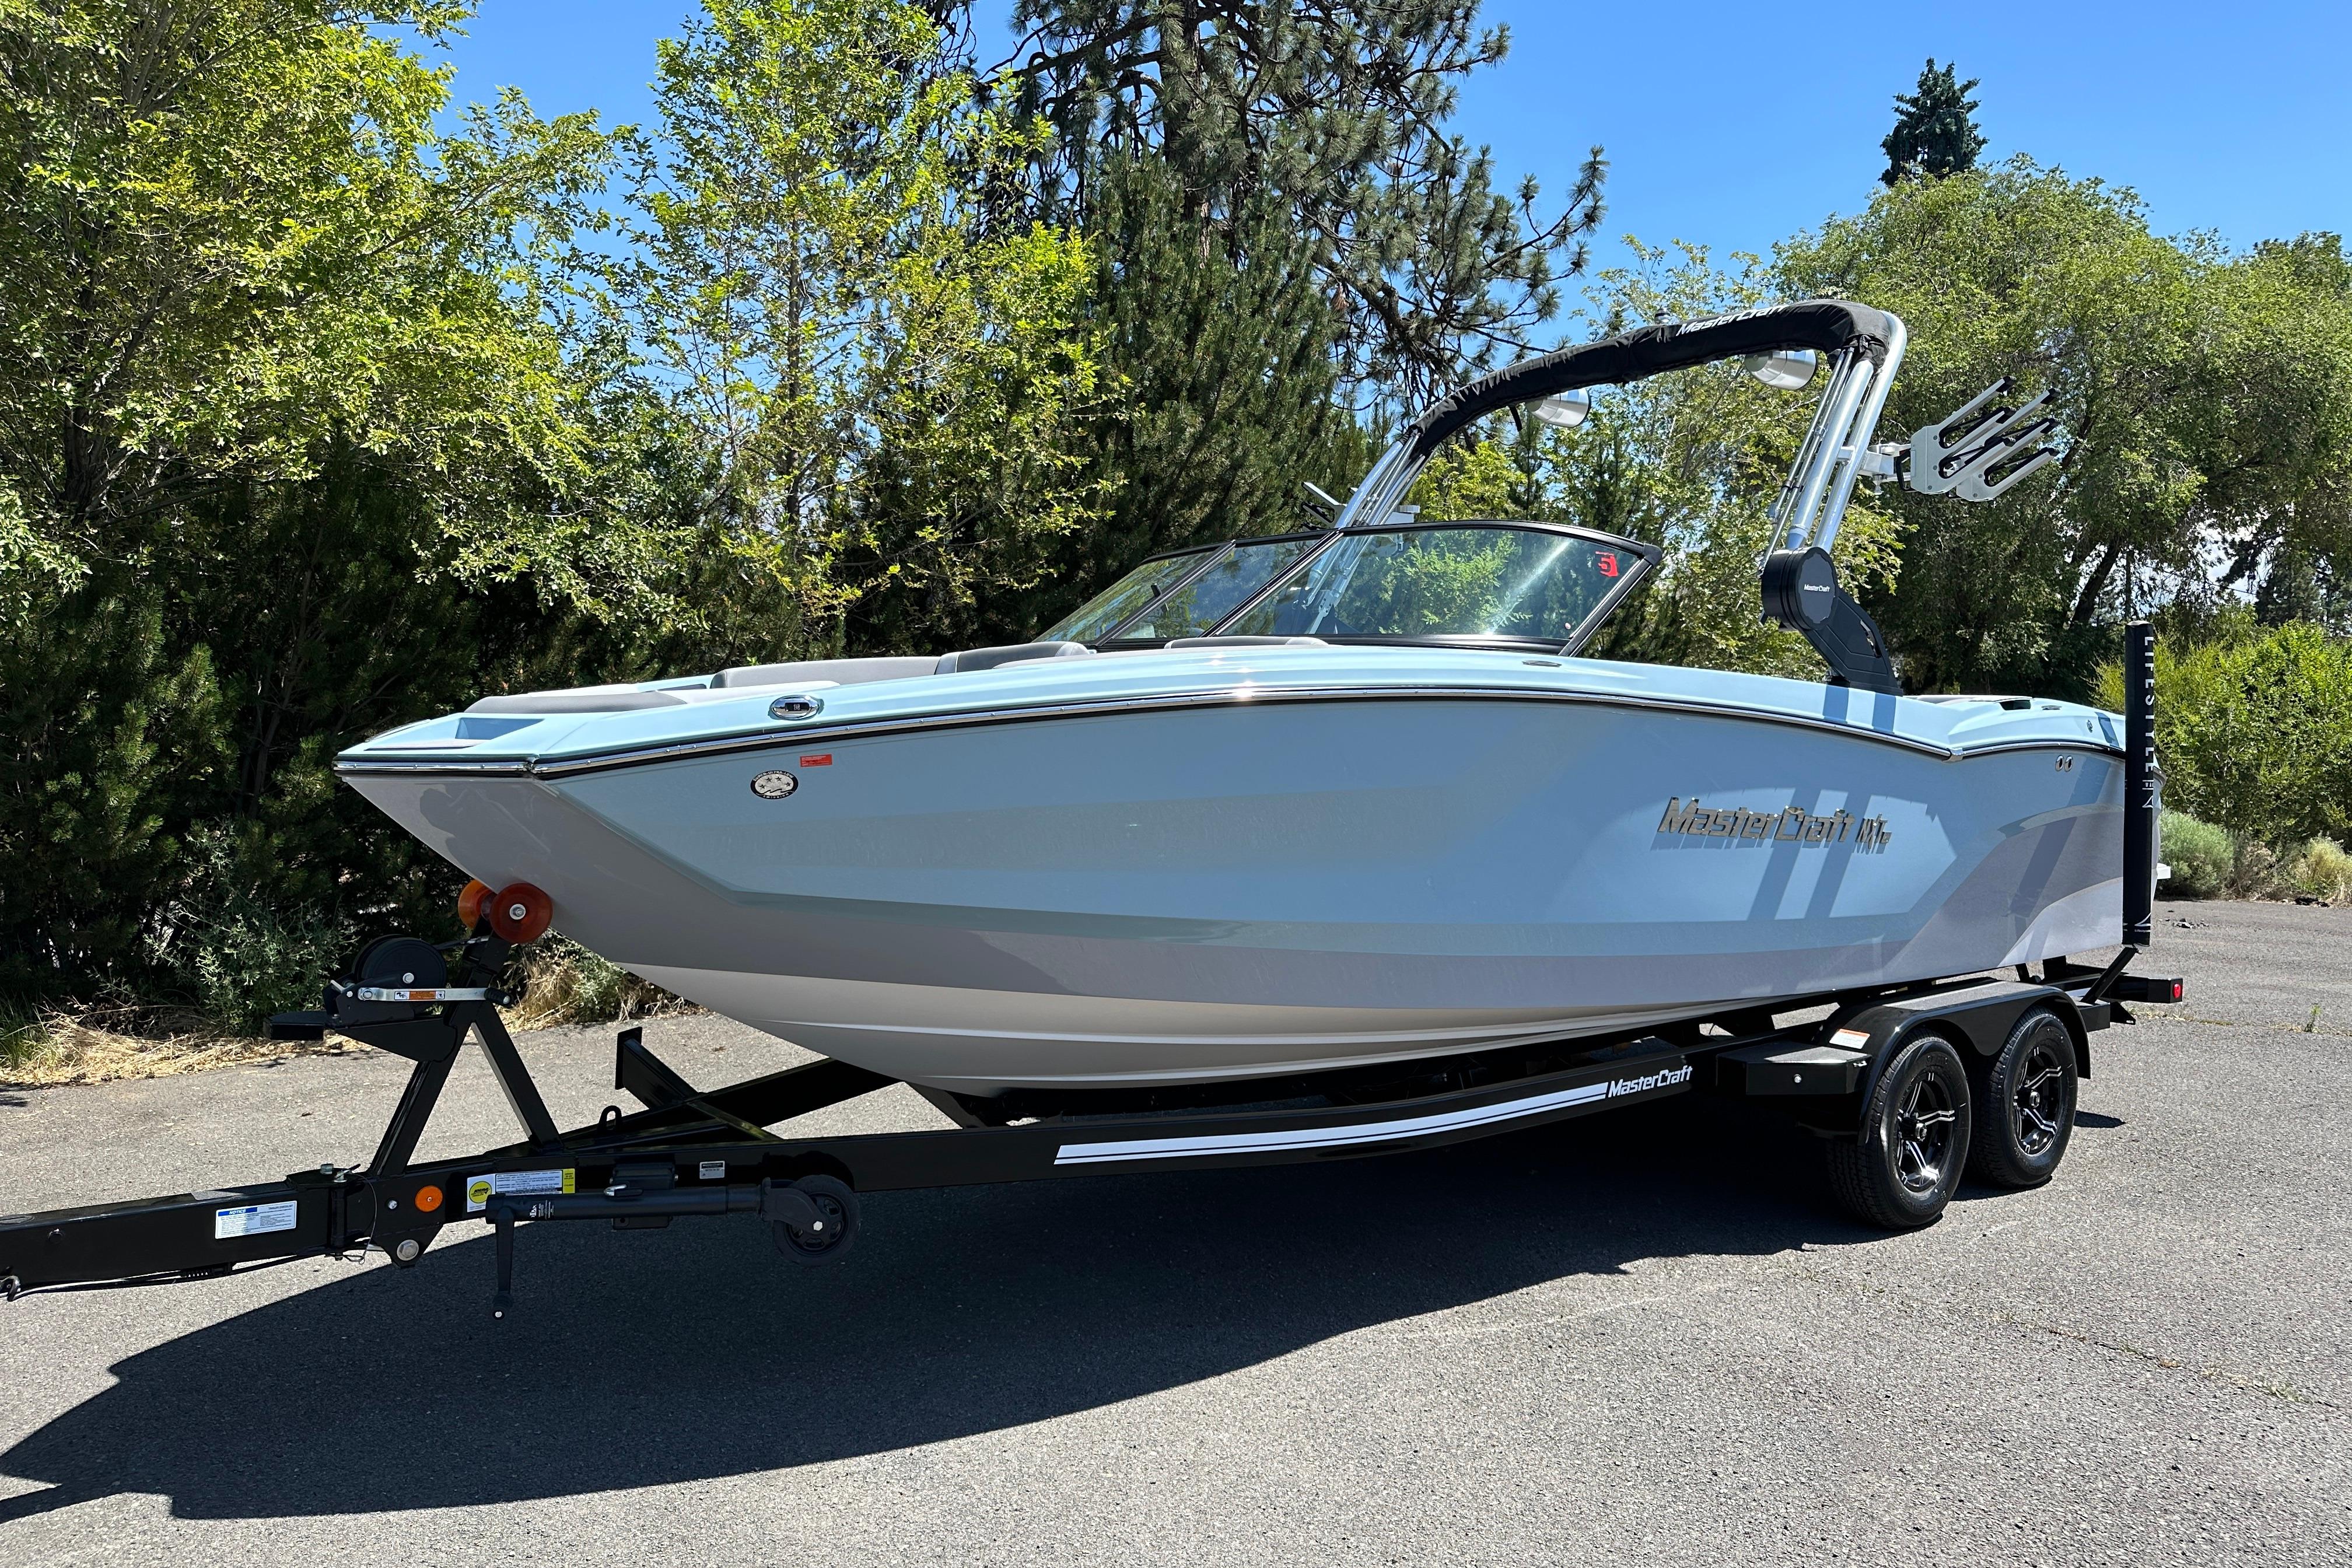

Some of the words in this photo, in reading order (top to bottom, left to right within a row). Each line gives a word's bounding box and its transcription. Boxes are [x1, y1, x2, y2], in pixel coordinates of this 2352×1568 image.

[1676, 304, 1788, 337] MasterCraft
[1804, 584, 1830, 592] MasterCraft
[1658, 797, 1856, 842] MasterCraft
[1608, 1065, 1692, 1098] MasterCraft
